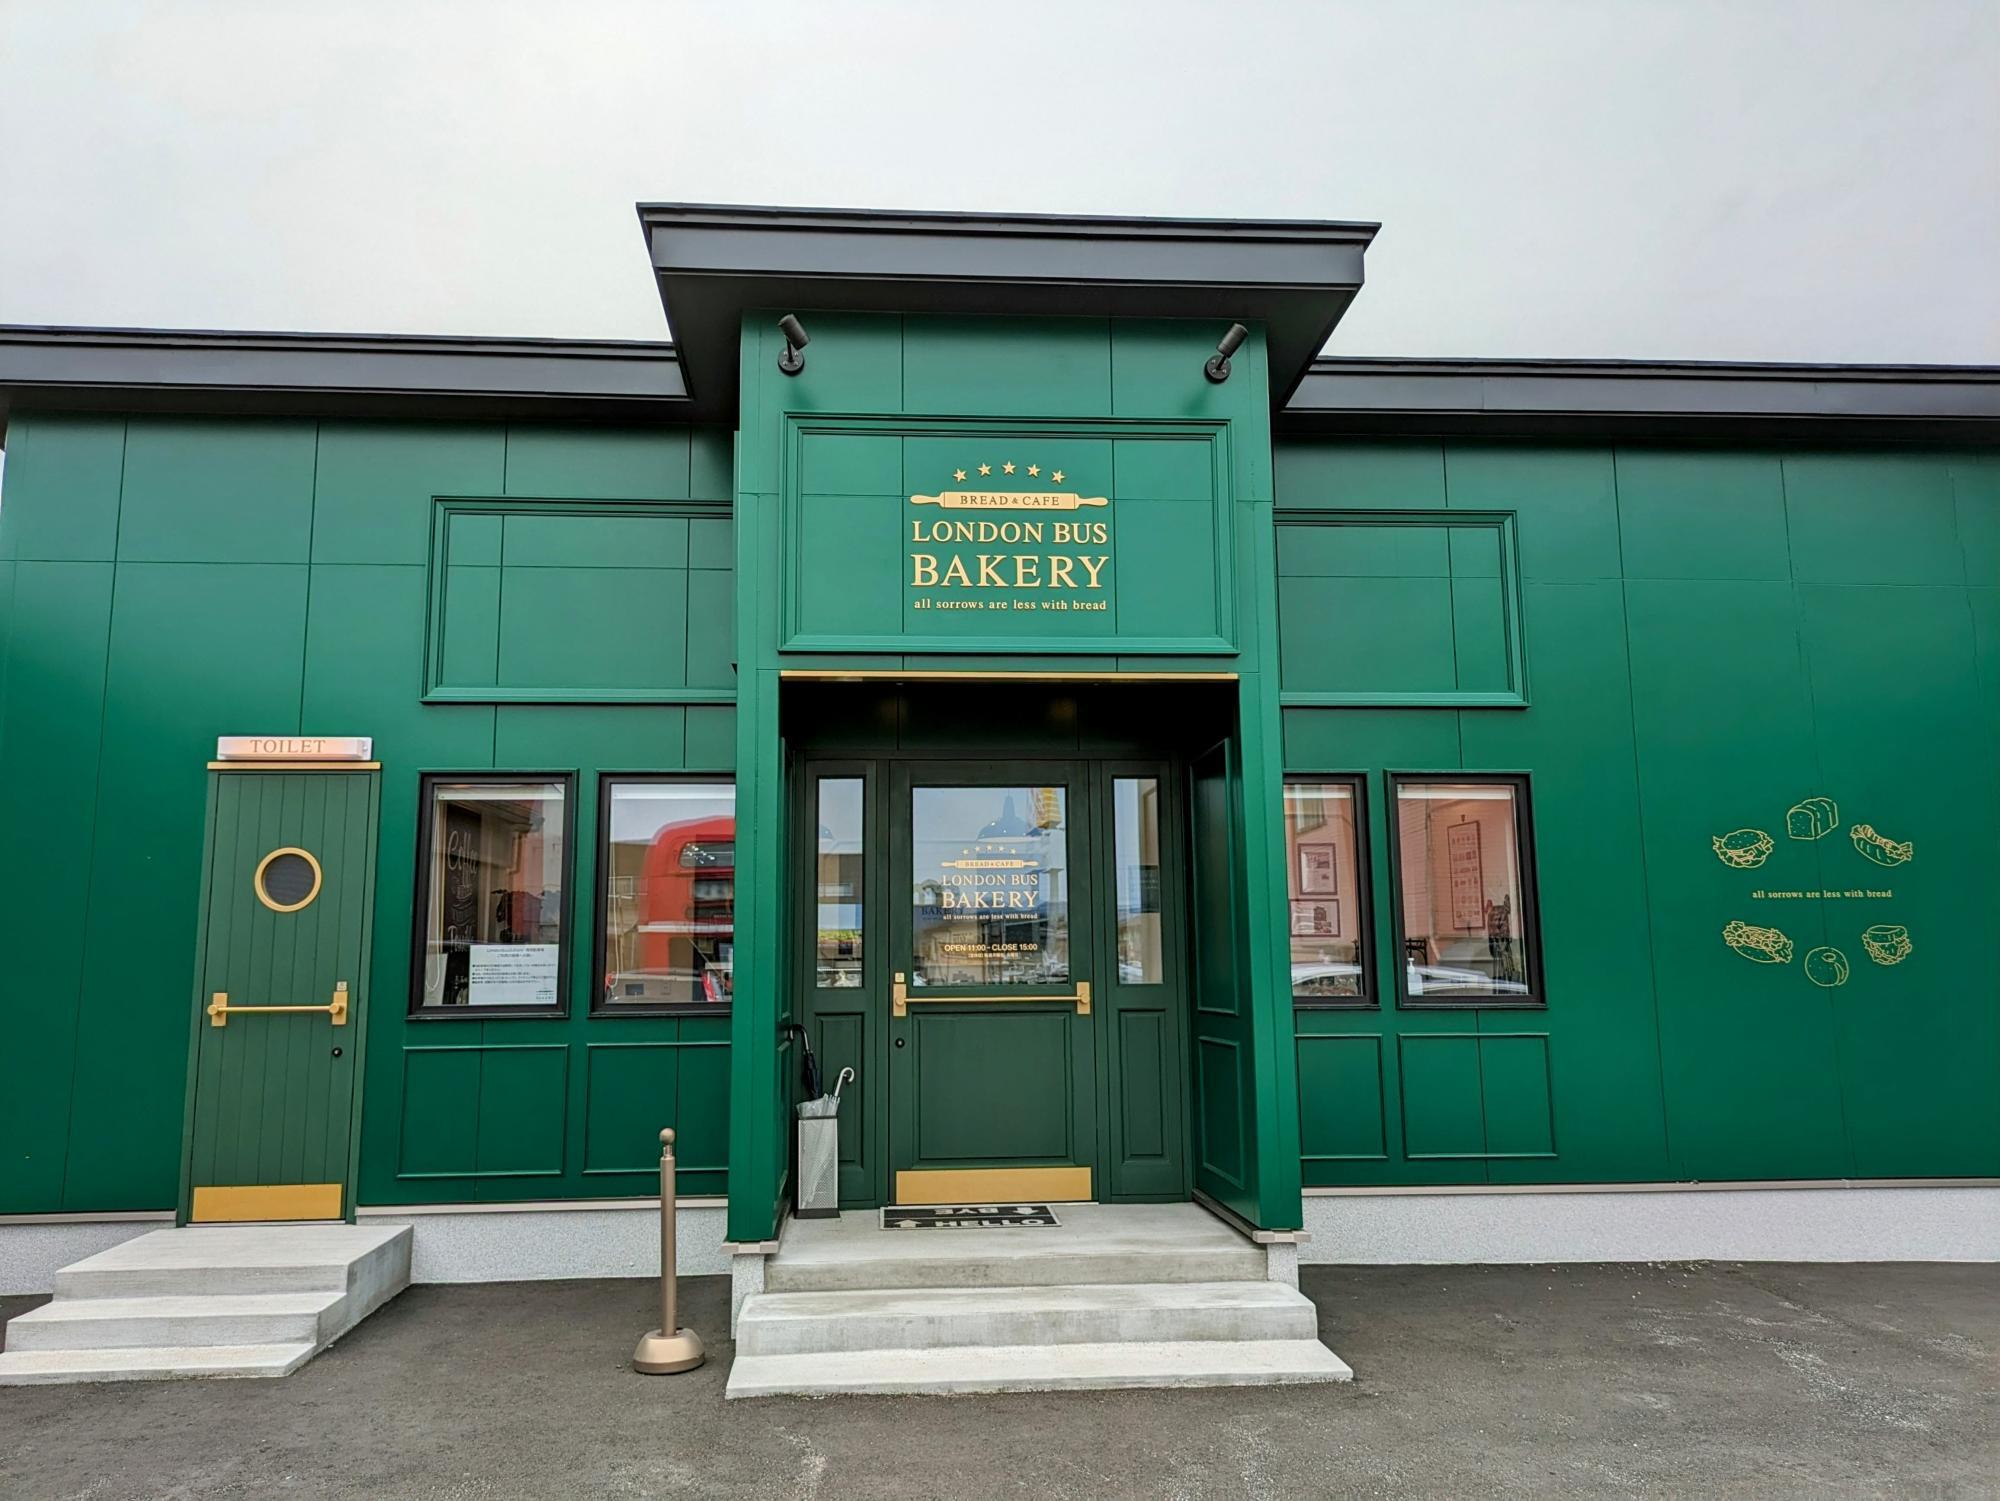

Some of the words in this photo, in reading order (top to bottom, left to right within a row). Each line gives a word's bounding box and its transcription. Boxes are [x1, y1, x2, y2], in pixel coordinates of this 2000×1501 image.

[960, 495, 1008, 505] BREAD
[1022, 496, 1060, 506] CAFE
[912, 521, 1044, 543] LONDON
[1052, 522, 1108, 544] BUS
[910, 554, 1109, 588] BAKERY
[914, 598, 931, 609] all
[936, 600, 984, 609] sorrows
[988, 601, 1008, 609] are
[1013, 599, 1036, 609] less
[1041, 599, 1068, 610] with
[1072, 600, 1107, 610] bread
[250, 739, 326, 753] TOILET
[942, 874, 1006, 886] LONDON
[1011, 874, 1038, 885] BUS
[942, 891, 1040, 908] BAKERY
[1752, 890, 1765, 898] all
[1823, 890, 1841, 898] less
[1843, 889, 1864, 897] with
[1866, 889, 1892, 897] bread
[944, 944, 966, 952] OPEN
[991, 943, 1018, 951] CLOSE
[1019, 943, 1038, 951] 15:00
[935, 1219, 1045, 1227] HELLO
